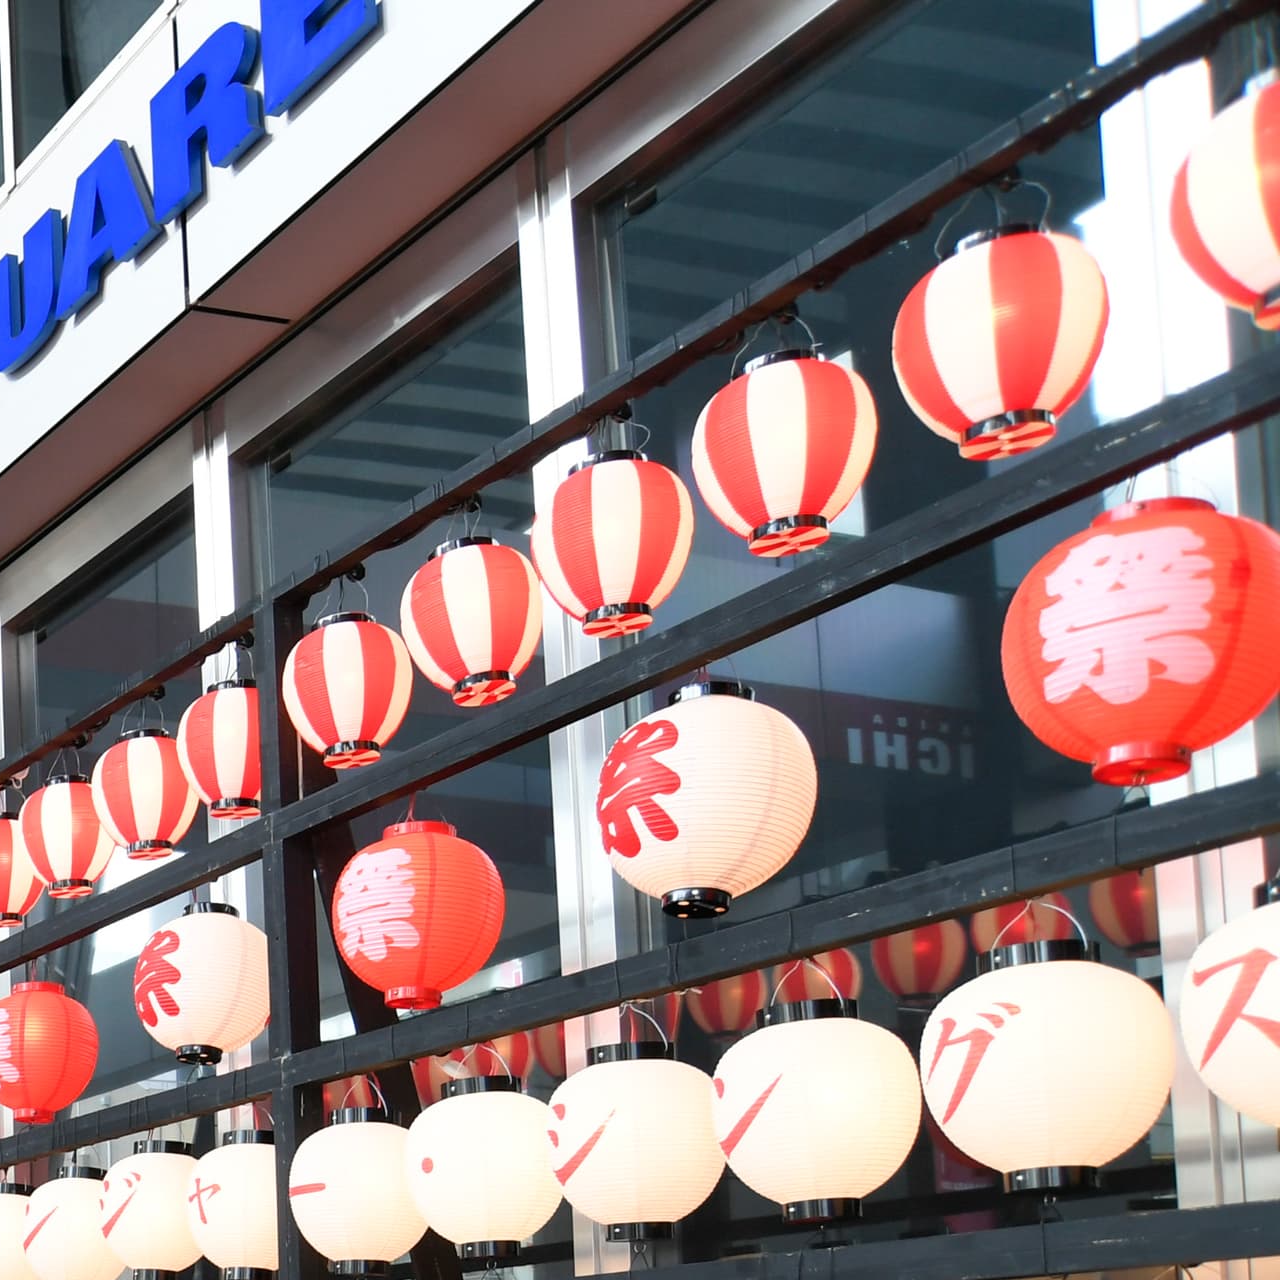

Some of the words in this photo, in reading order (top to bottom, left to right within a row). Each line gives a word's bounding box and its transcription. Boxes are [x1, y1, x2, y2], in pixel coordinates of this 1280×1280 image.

[1040, 525, 1217, 706] 祭
[598, 718, 682, 860] 祭
[334, 847, 421, 962] 祭
